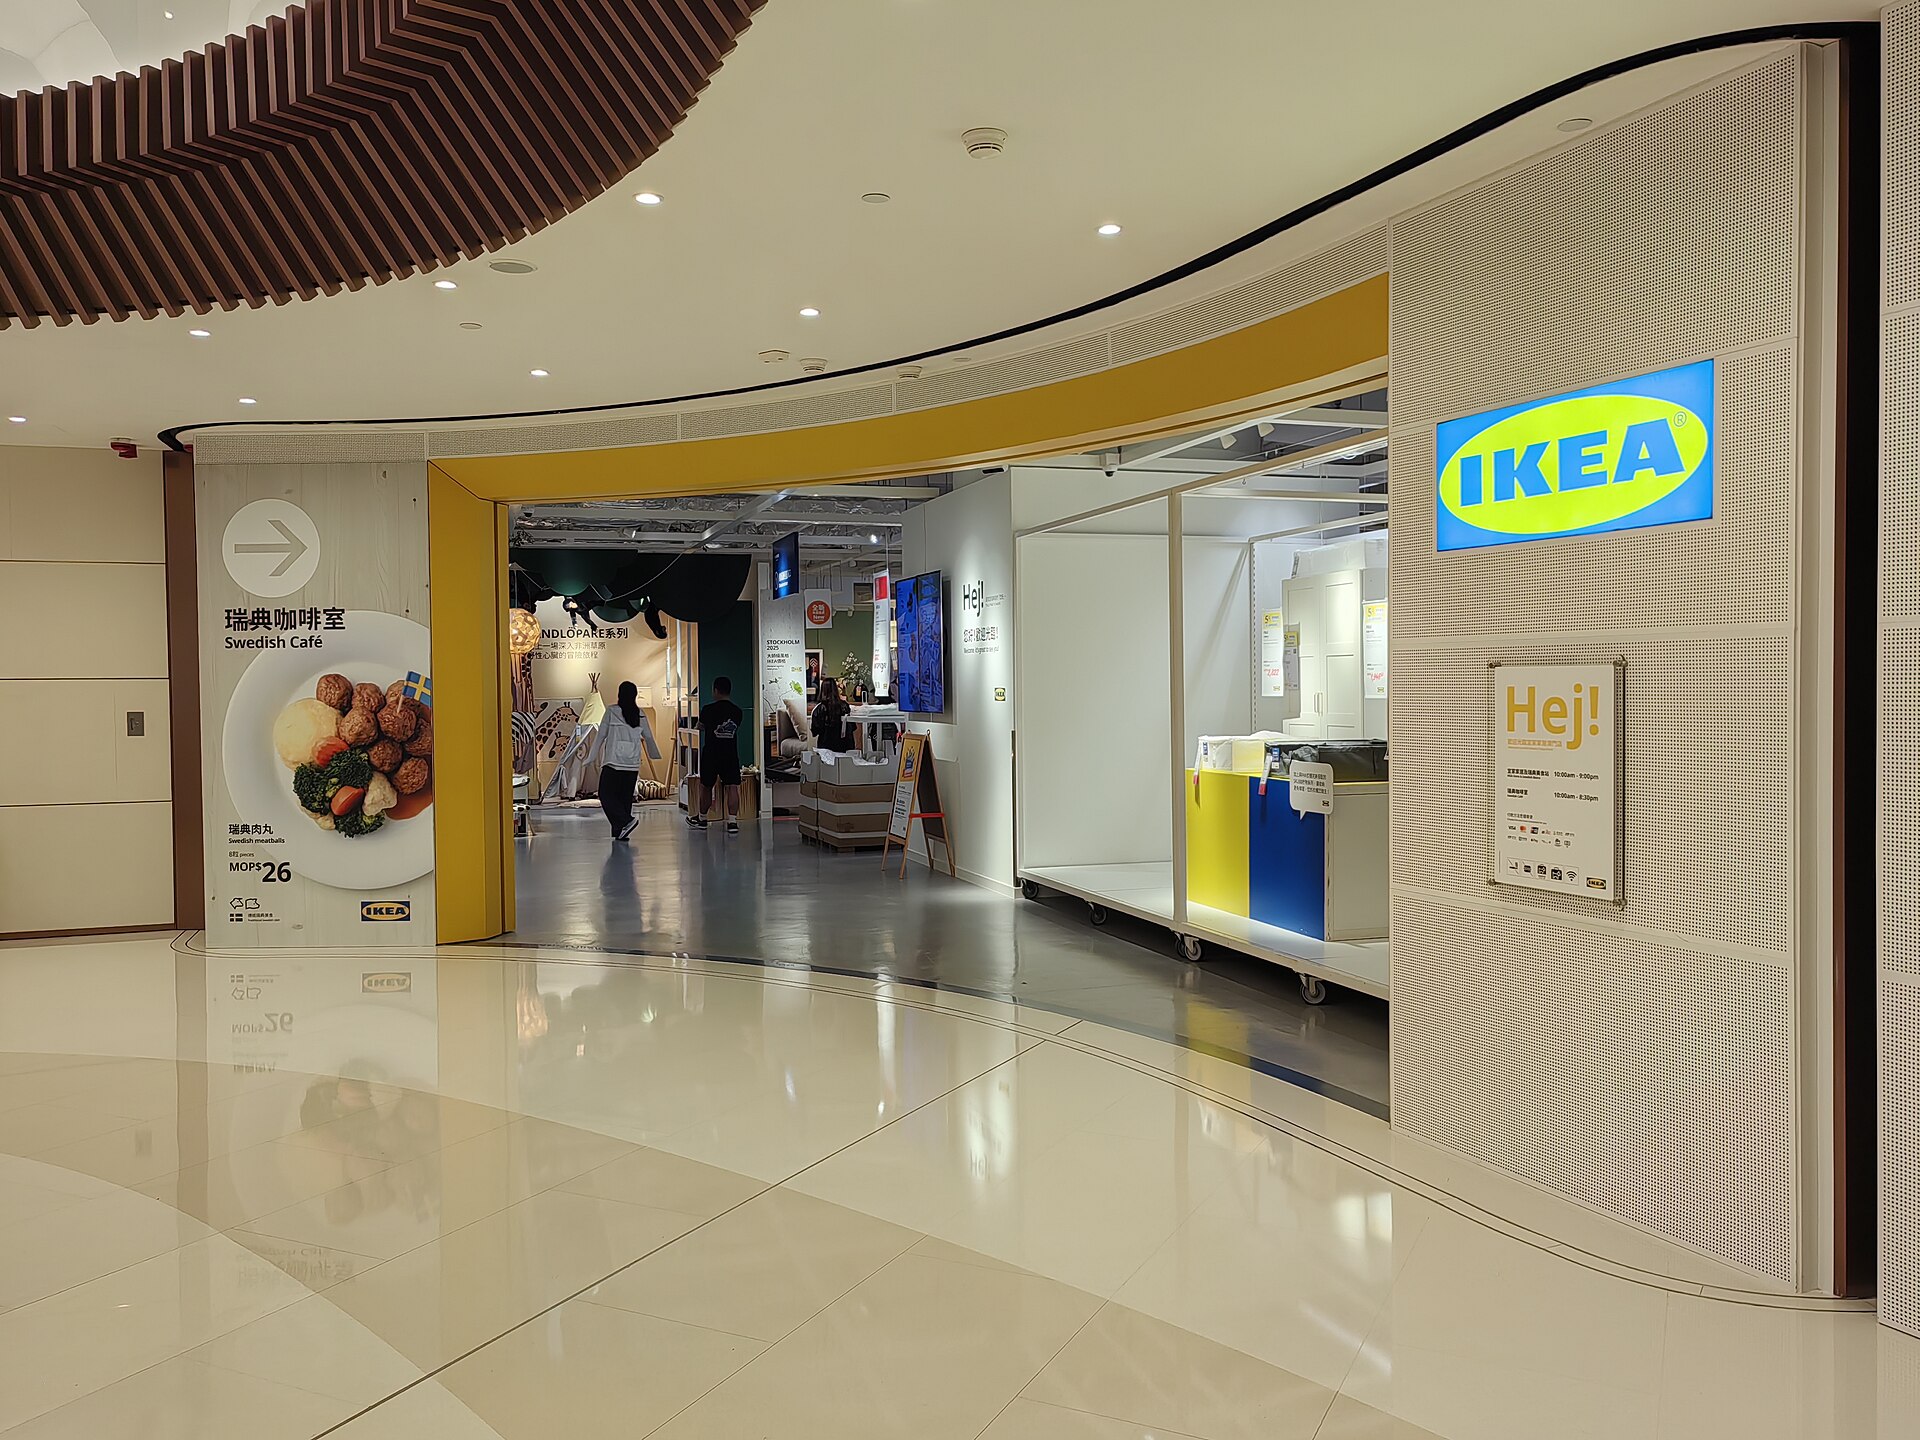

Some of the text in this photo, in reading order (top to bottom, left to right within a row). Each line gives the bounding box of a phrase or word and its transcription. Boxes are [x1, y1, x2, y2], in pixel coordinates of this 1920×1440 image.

[1460, 417, 1686, 508] IKEA
[963, 580, 984, 617] Hej!
[224, 606, 346, 632] 瑞典咖啡室
[540, 626, 628, 639] NDLÖPARE系列
[224, 635, 323, 649] Swedish Café
[1507, 683, 1599, 750] Hej!
[1578, 773, 1599, 781] 9:00pm
[1553, 792, 1576, 800] 10:00am
[1578, 794, 1599, 802] 8:30pm
[228, 823, 274, 835] 瑞典肉丸
[366, 906, 407, 916] IKEA
